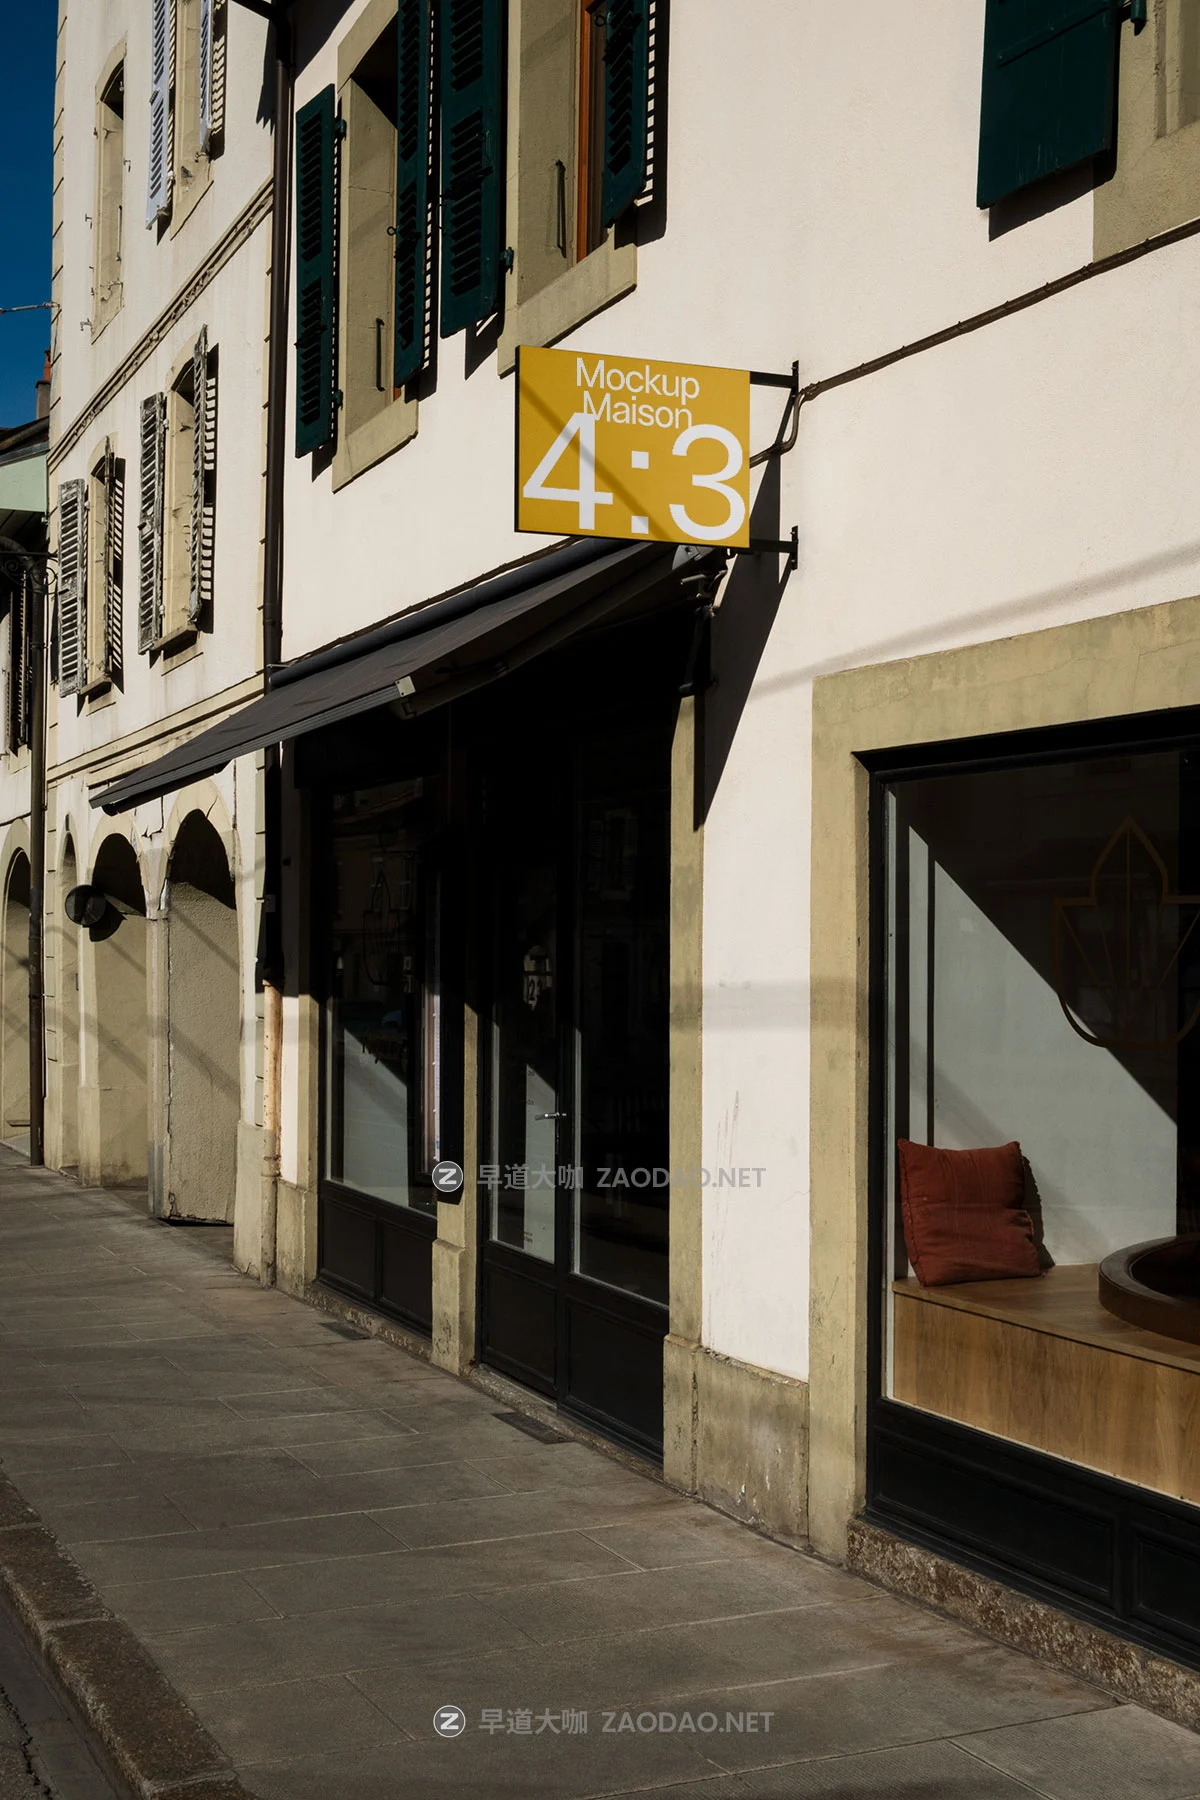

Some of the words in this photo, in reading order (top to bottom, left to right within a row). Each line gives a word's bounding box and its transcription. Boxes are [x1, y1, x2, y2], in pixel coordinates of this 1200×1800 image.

[577, 357, 700, 405] Mockup
[583, 390, 692, 429] Maison
[523, 412, 746, 541] 4:3
